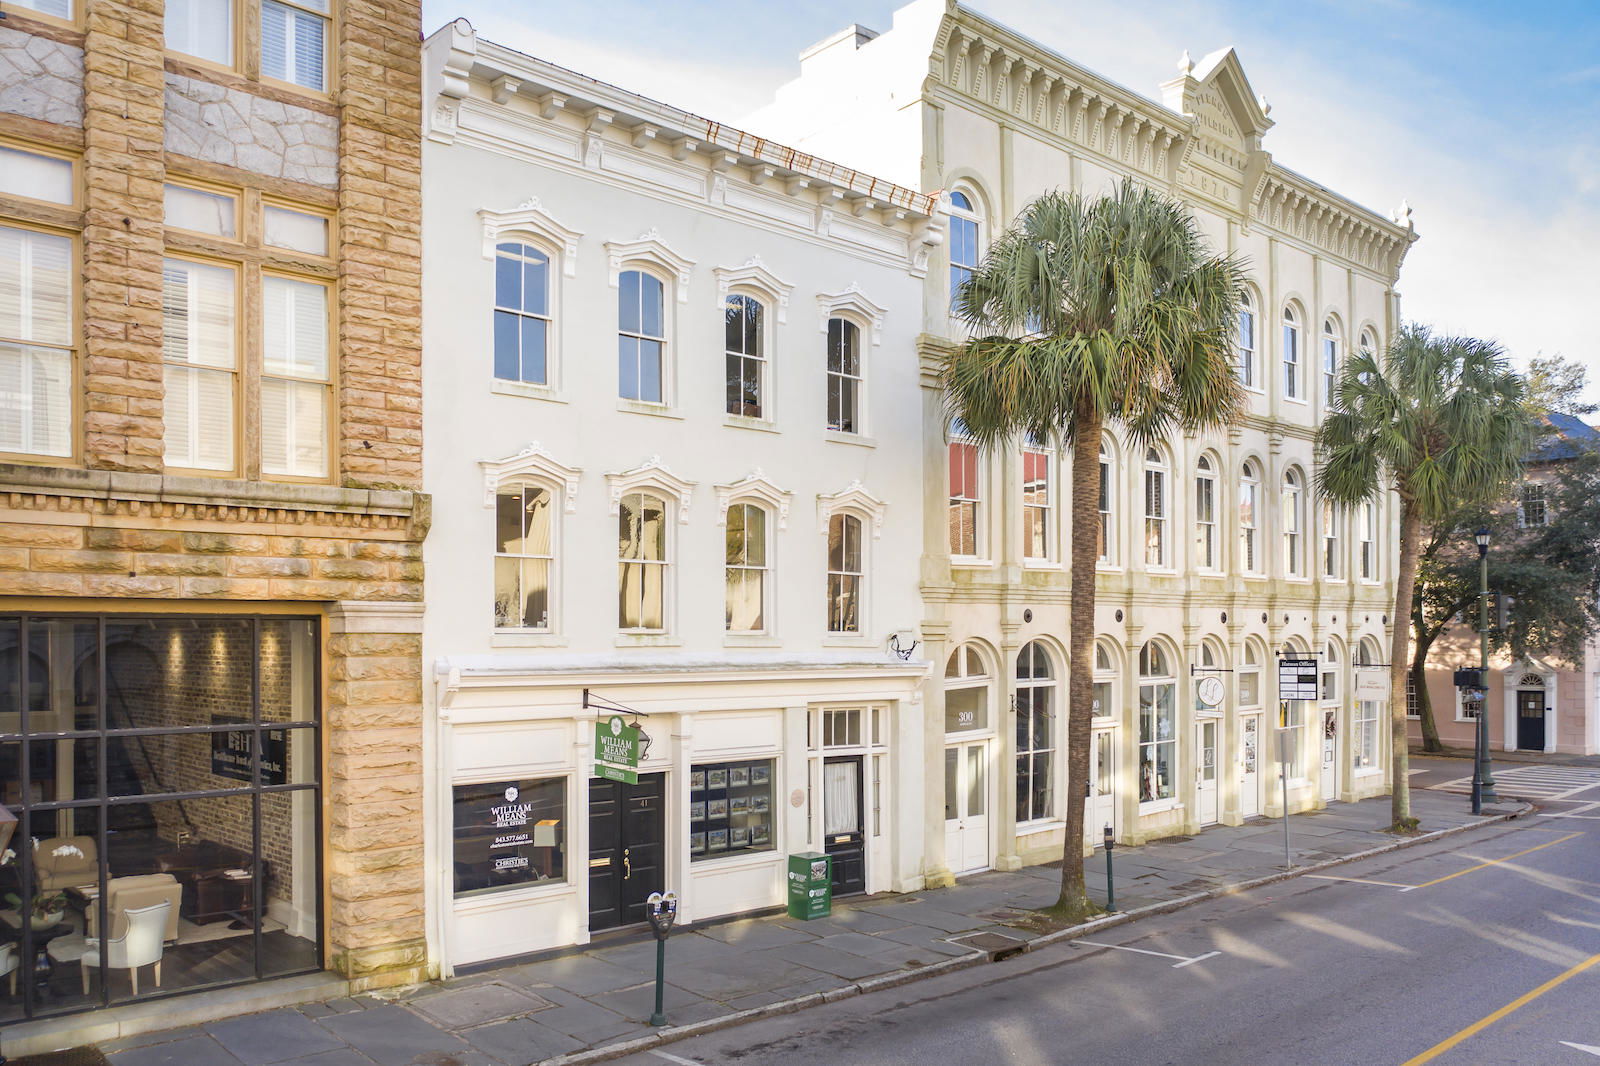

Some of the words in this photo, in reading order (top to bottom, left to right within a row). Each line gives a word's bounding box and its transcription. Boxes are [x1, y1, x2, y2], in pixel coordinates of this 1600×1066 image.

[958, 711, 973, 722] 300
[600, 736, 632, 750] WILLIAM
[604, 745, 628, 757] MEANS
[613, 756, 628, 764] ESTATE
[640, 799, 648, 808] 41
[491, 804, 532, 816] WILLIAM
[496, 811, 527, 822] MEANS
[495, 857, 529, 867] CHRISTIE'S
